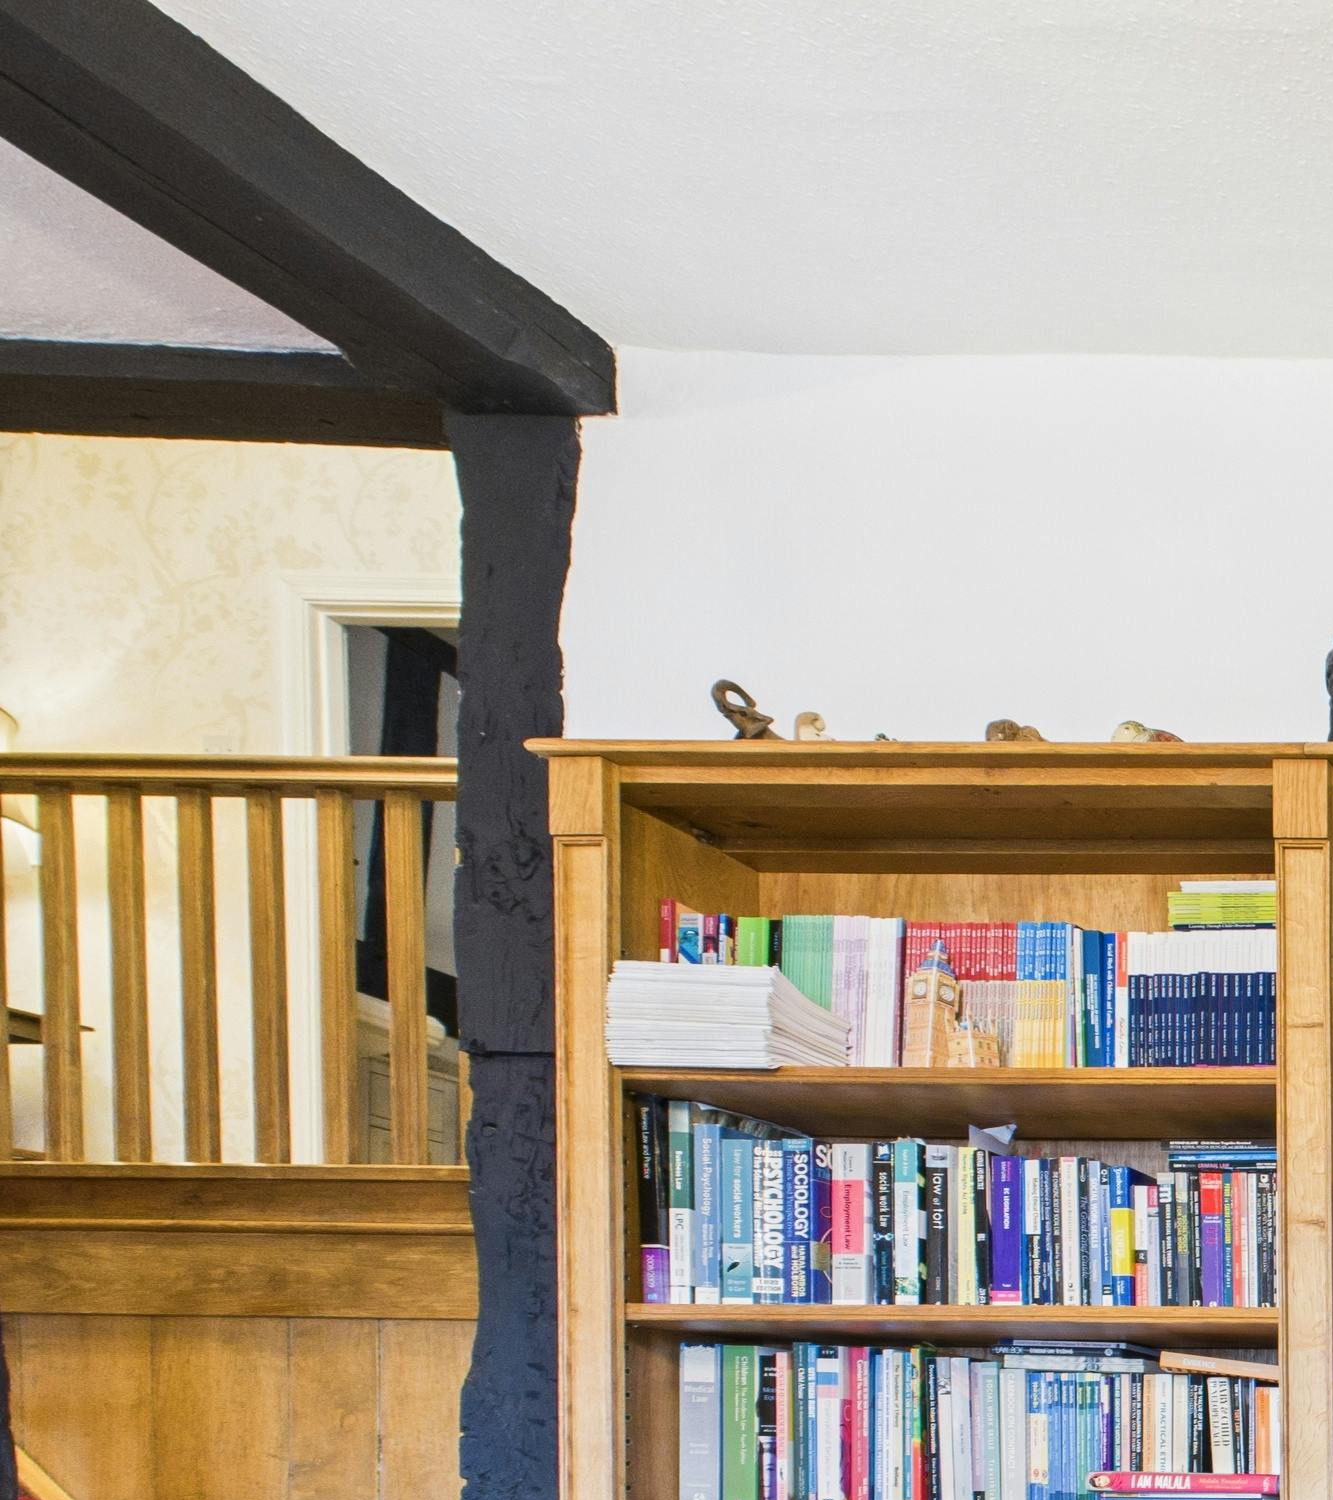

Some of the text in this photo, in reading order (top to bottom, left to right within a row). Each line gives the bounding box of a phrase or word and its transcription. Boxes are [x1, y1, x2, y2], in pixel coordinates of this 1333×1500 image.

[794, 1153, 809, 1238] SOCIOLOGY
[932, 1172, 945, 1194] law
[763, 1161, 784, 1269] PSYCHOLOGY
[842, 1184, 852, 1250] Employment Law
[932, 1208, 944, 1230] tort
[790, 1259, 799, 1297] HOLBORN
[798, 1244, 806, 1297] HARALAMBOS
[1140, 1475, 1159, 1489] AM
[1161, 1475, 1192, 1490] MALALA
